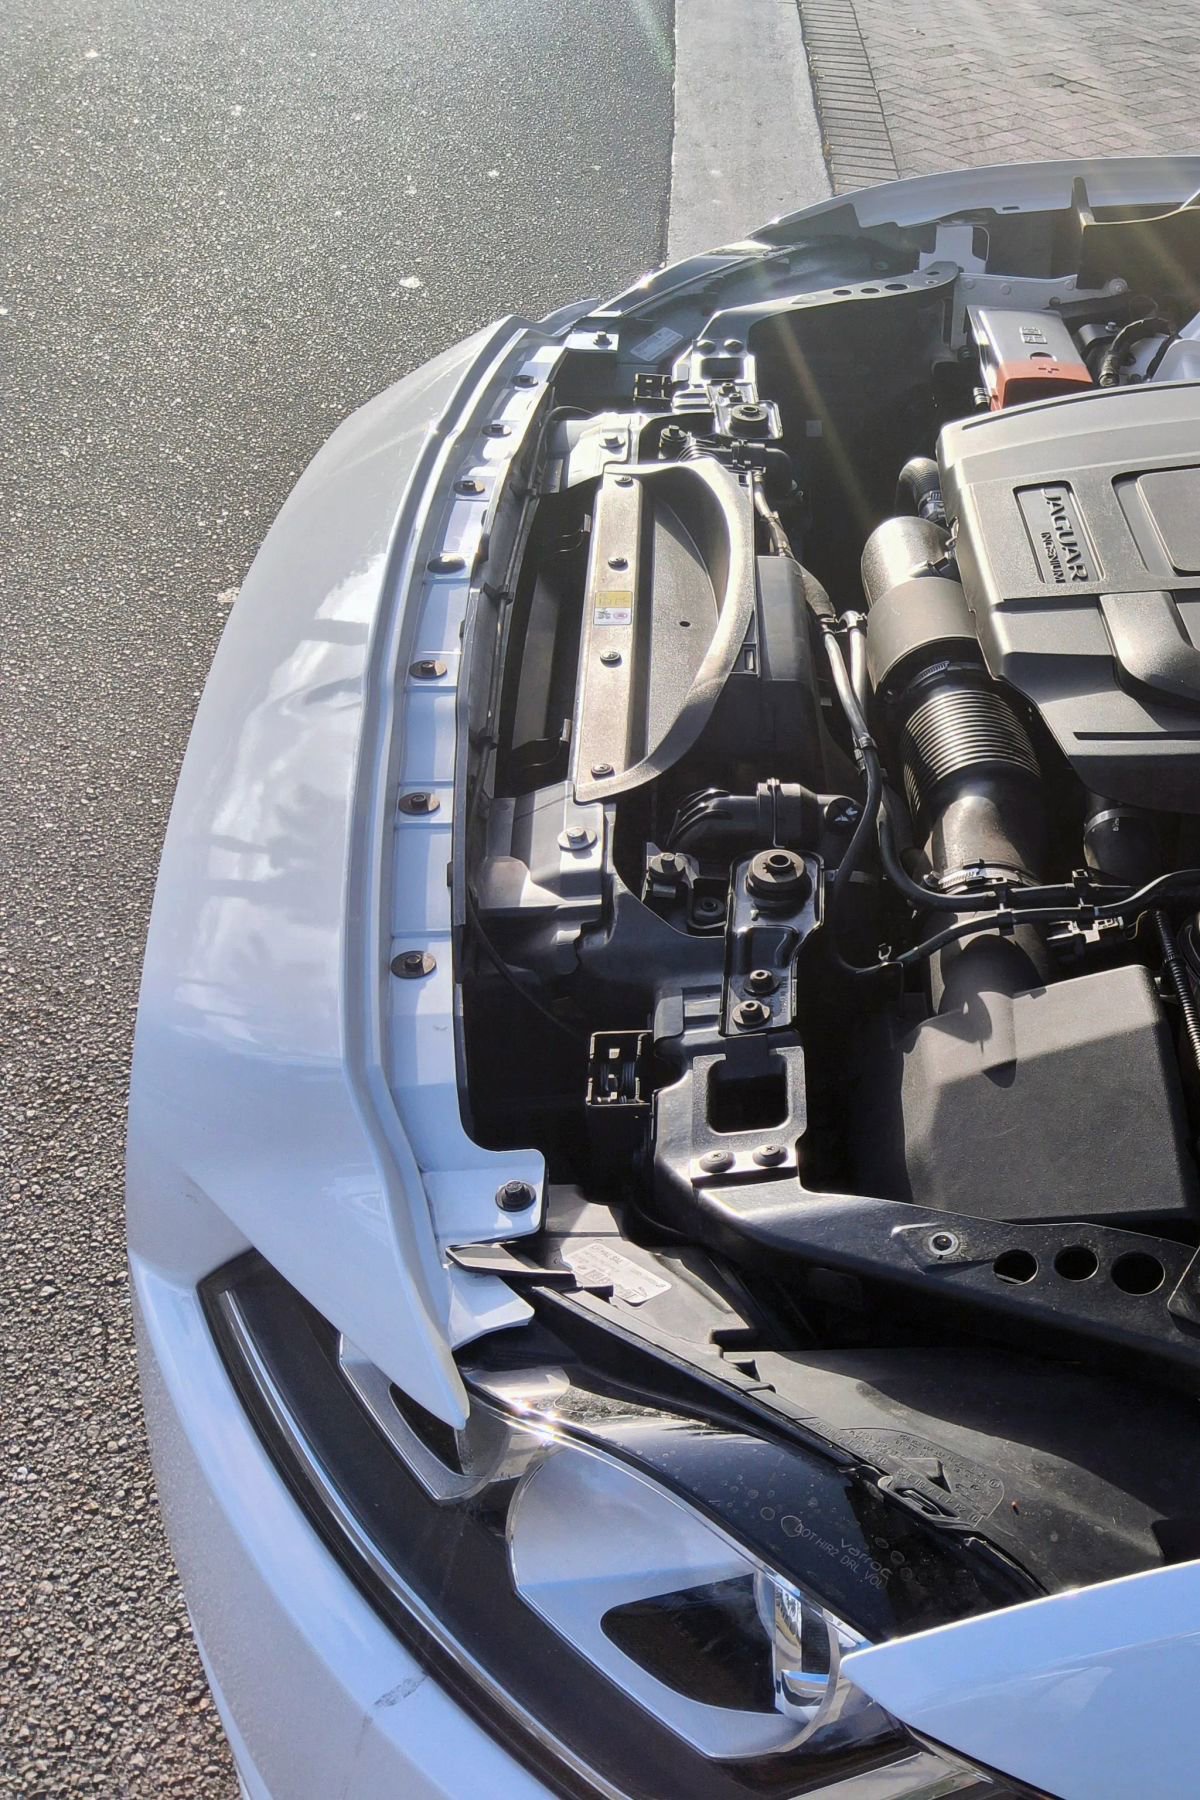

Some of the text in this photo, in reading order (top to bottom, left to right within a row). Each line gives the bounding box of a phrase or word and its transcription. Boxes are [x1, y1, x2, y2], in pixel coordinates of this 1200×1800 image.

[1041, 488, 1088, 581] JAGUAR
[794, 1523, 817, 1540] DOT
[815, 1538, 840, 1557] HIR2
[840, 1555, 861, 1573] DRL
